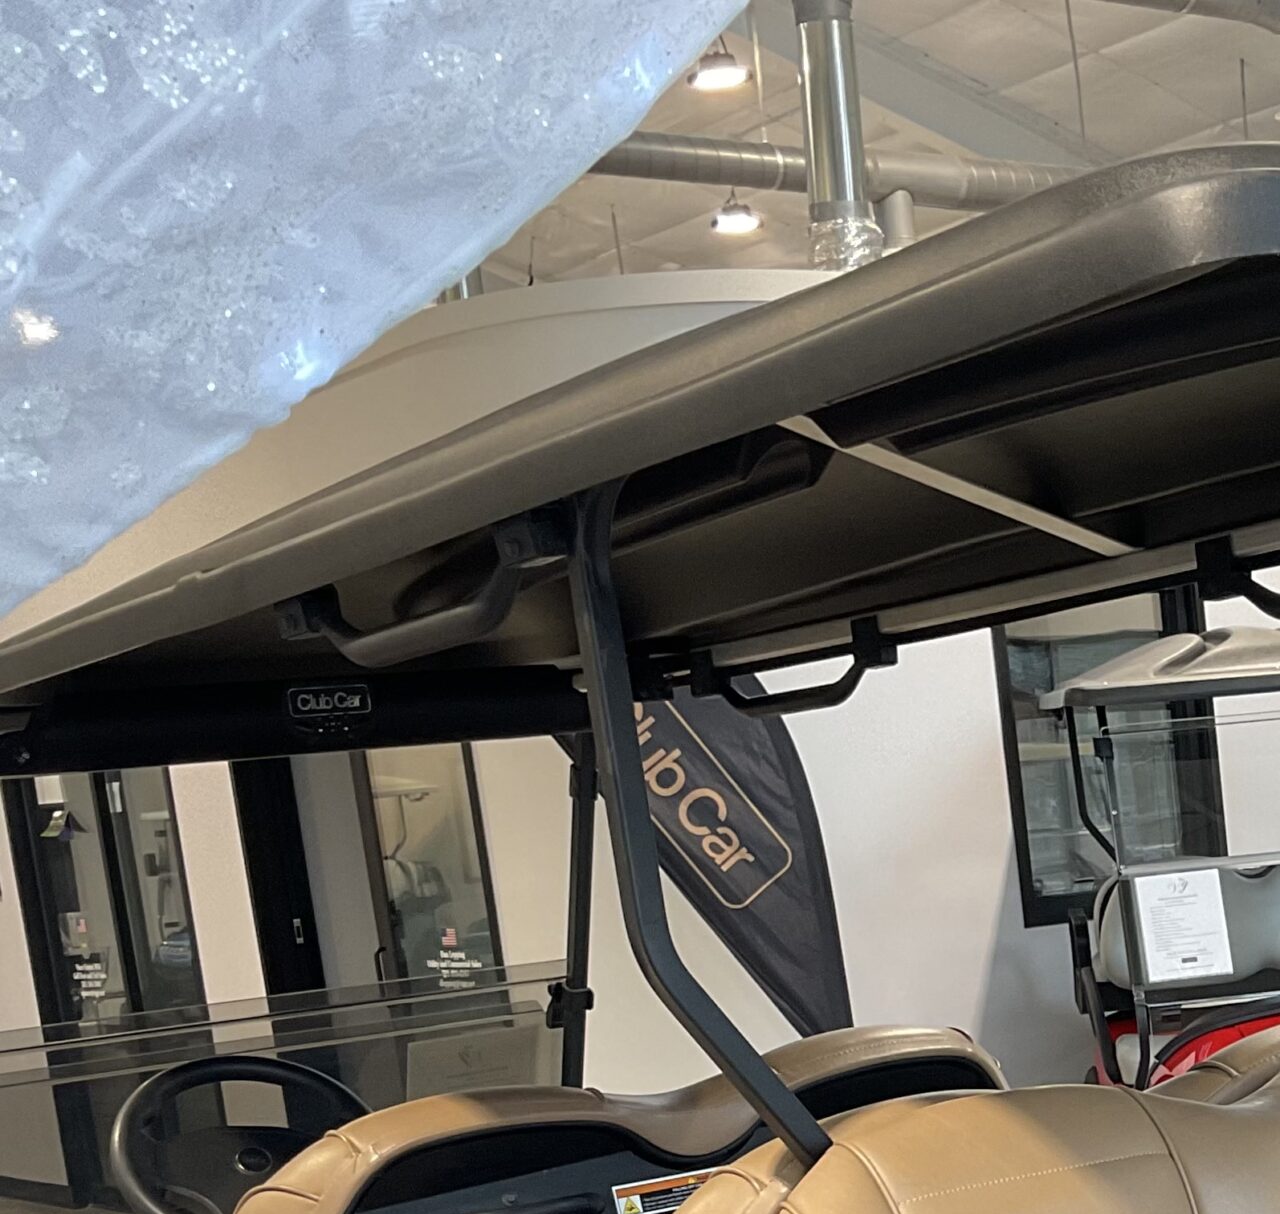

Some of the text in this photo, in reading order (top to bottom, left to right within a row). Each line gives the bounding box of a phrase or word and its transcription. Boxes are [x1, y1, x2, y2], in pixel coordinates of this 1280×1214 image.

[297, 692, 361, 710] Club Car
[678, 787, 756, 873] Car
